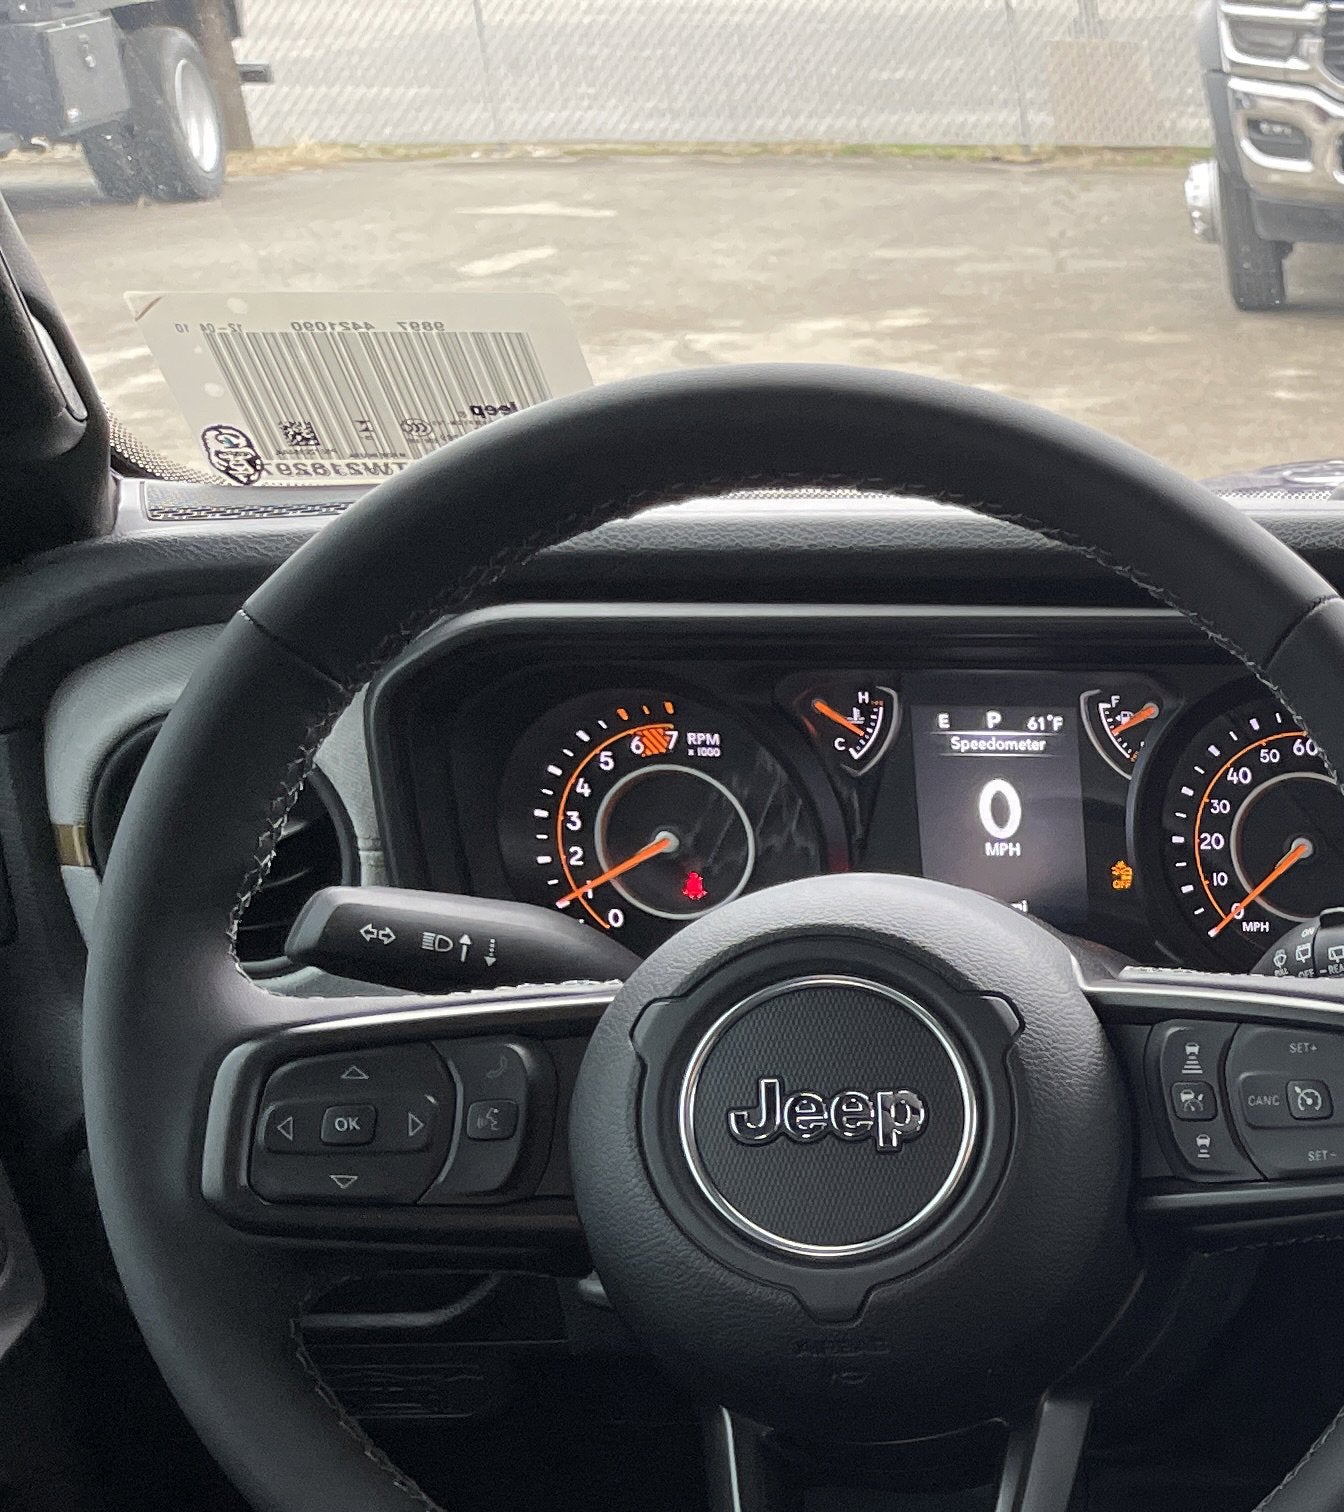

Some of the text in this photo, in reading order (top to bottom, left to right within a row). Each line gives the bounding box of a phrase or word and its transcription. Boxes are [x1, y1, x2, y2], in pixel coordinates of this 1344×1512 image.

[858, 692, 869, 704] H
[1111, 695, 1120, 708] F
[938, 714, 949, 729] E
[987, 711, 1001, 729] P
[630, 735, 644, 755] 6
[687, 733, 720, 747] RPM
[834, 737, 846, 751] C
[951, 735, 1046, 753] Speedometer
[1292, 740, 1318, 756] 60
[697, 746, 721, 757] 1000
[1260, 748, 1280, 763] 50
[599, 752, 614, 771] 5
[1227, 767, 1252, 785] 40
[575, 778, 590, 796] 4
[979, 778, 1021, 839] 0
[1210, 799, 1230, 815] 30
[566, 811, 582, 829] 3
[985, 842, 1021, 857] MPH
[1200, 834, 1224, 850] 20
[569, 847, 584, 865] 2
[1212, 872, 1228, 887] 10
[608, 909, 624, 927] 0
[1242, 920, 1269, 933] MPH
[1248, 1096, 1280, 1106] CANC
[727, 1077, 928, 1152] Jeep
[334, 1117, 360, 1132] OK
